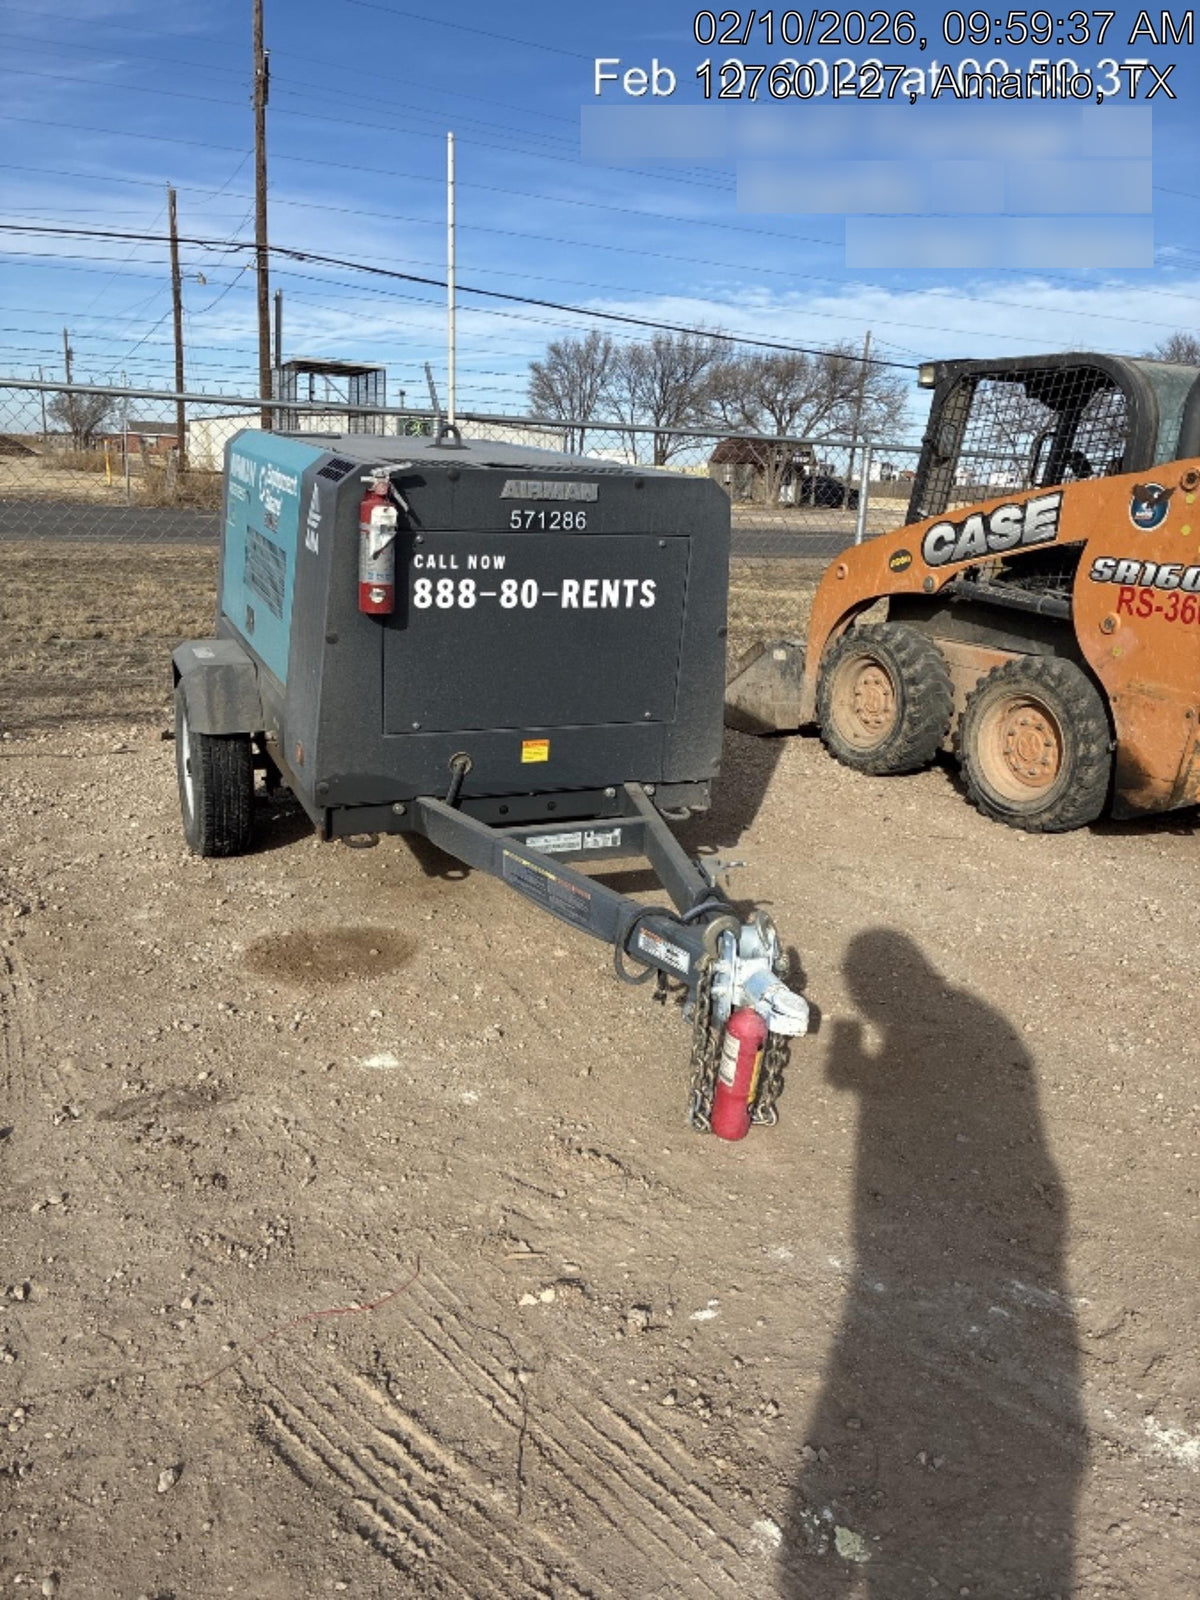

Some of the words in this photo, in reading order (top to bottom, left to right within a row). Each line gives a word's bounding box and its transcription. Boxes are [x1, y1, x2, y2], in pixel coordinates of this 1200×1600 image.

[500, 479, 599, 503] AIRMAN
[509, 509, 587, 531] 571286
[922, 491, 1063, 567] CASE
[413, 553, 459, 569] CALL
[467, 554, 506, 570] NOW
[413, 577, 657, 609] 888-80-RENTS
[1116, 586, 1200, 626] RS-36
